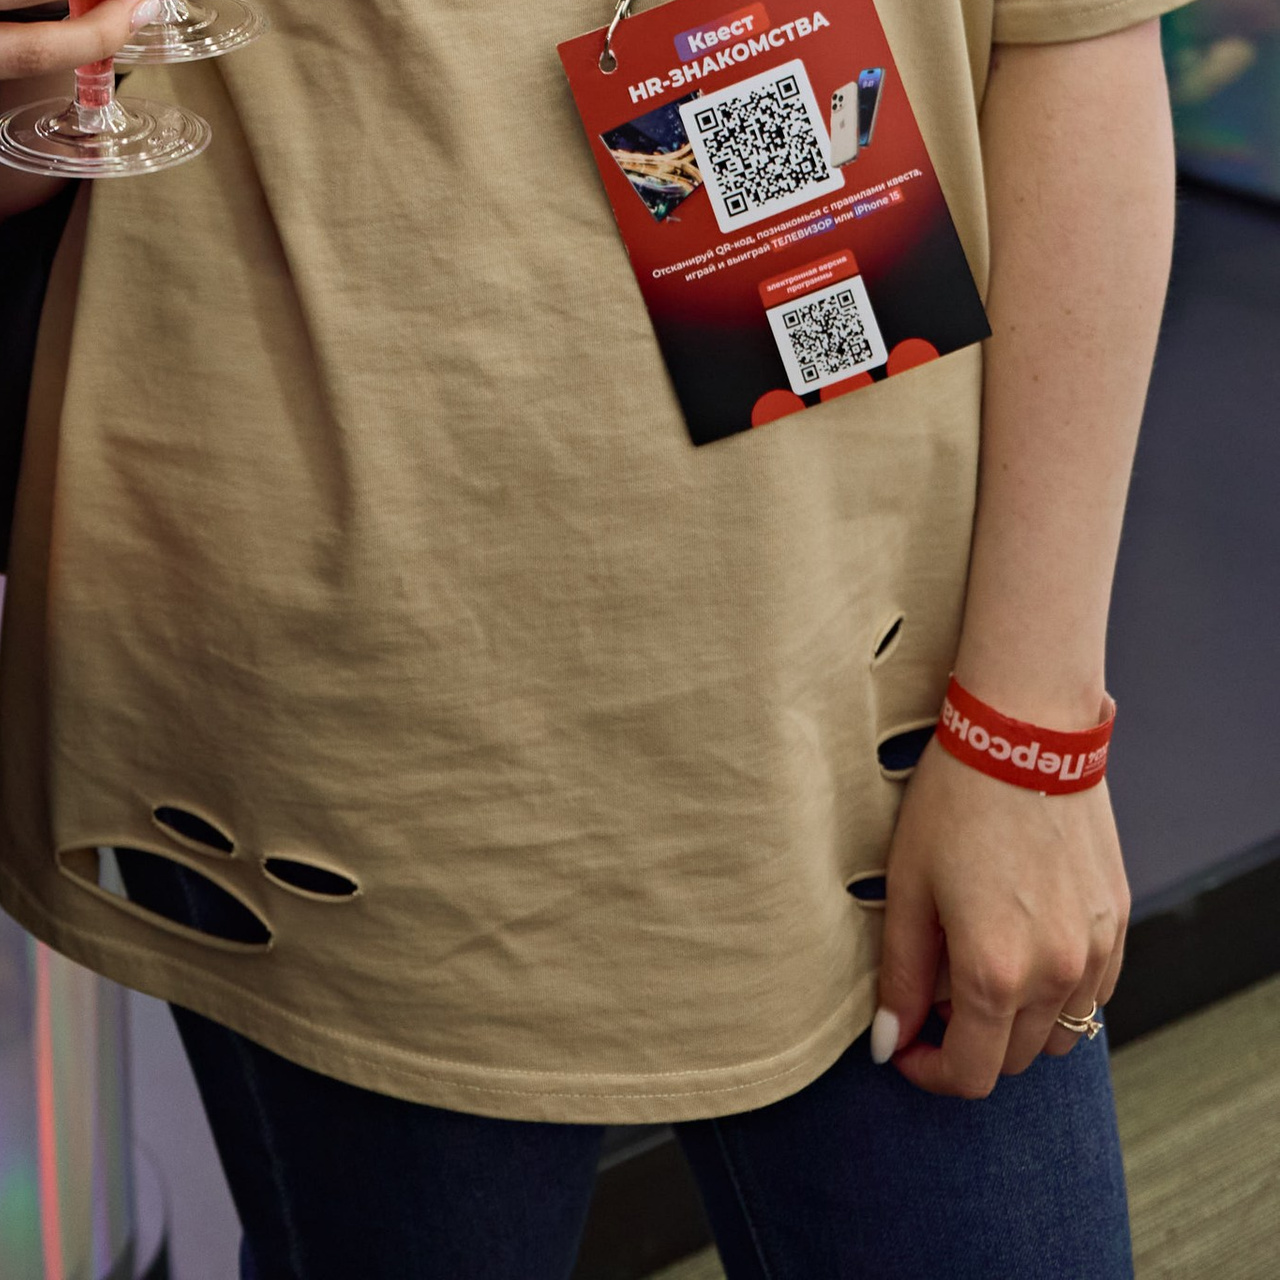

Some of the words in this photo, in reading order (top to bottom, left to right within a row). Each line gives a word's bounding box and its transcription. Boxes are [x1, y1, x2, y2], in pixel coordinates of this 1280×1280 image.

[627, 10, 830, 105] HR-ЗНАКОМСТВА
[686, 14, 755, 54] Квест
[652, 248, 715, 279] Отсканируй
[715, 235, 756, 256] QR-код,
[756, 208, 822, 241] познакомься
[822, 205, 830, 214] с
[830, 182, 886, 212] правилами
[886, 168, 923, 189] квеста,
[684, 264, 717, 282] играй
[717, 261, 726, 270] и
[726, 242, 771, 267] выиграй
[771, 217, 833, 249] ТЕЛЕВИЗОР
[834, 211, 854, 225] или
[853, 195, 889, 217] iPhone
[889, 190, 901, 202] 15
[766, 267, 818, 292] электронная
[818, 255, 848, 272] версия
[786, 271, 833, 294] программы
[942, 696, 1086, 781] Персона
